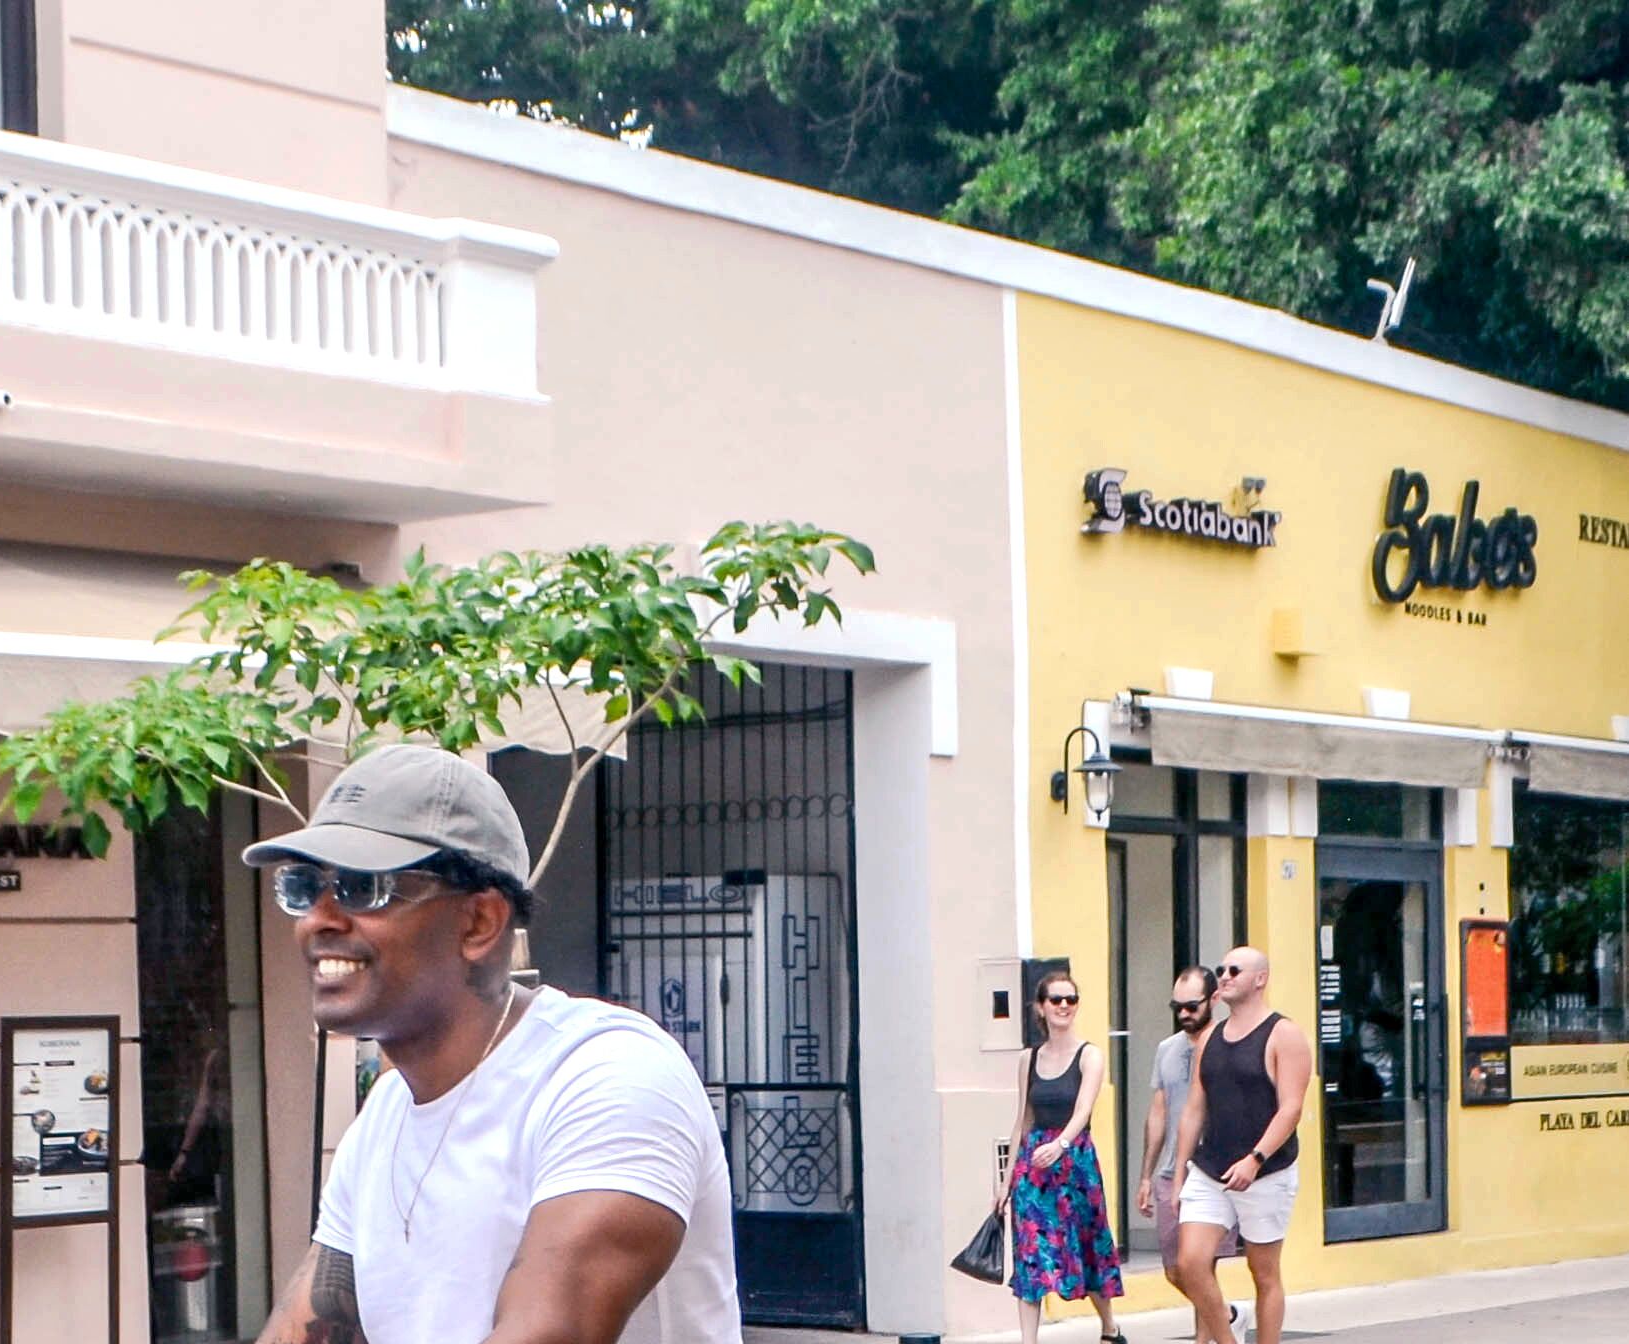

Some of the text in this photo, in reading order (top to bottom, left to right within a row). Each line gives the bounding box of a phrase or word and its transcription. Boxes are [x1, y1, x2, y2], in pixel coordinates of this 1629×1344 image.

[1137, 489, 1281, 547] Scotiabank
[1405, 602, 1451, 621] NOODLES
[1468, 612, 1486, 626] BAR
[614, 884, 744, 904] HIELO
[1539, 1113, 1575, 1131] PLAYA
[1580, 1111, 1602, 1129] DEL
